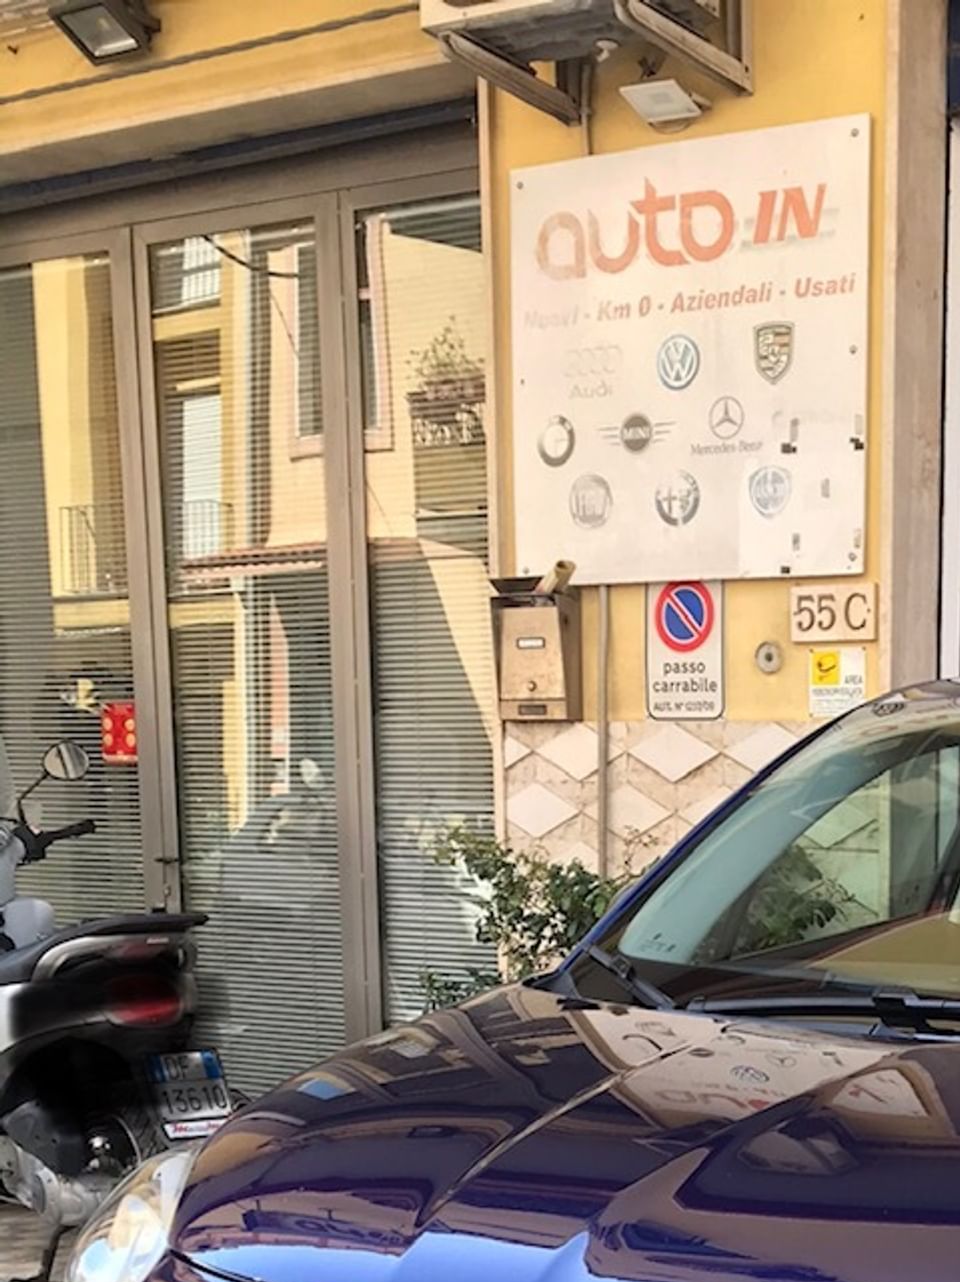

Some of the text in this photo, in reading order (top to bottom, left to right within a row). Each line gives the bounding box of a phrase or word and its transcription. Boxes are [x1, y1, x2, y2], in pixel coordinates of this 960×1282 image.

[535, 177, 827, 281] auto IN
[596, 300, 632, 322] Km
[638, 295, 652, 318] 0
[670, 282, 773, 315] Aziendali
[794, 272, 856, 299] Usati
[568, 379, 613, 400] Audi
[793, 592, 867, 632] 55 C
[662, 661, 707, 677] passo
[652, 677, 719, 694] carrabile
[162, 1084, 228, 1115] 13610
